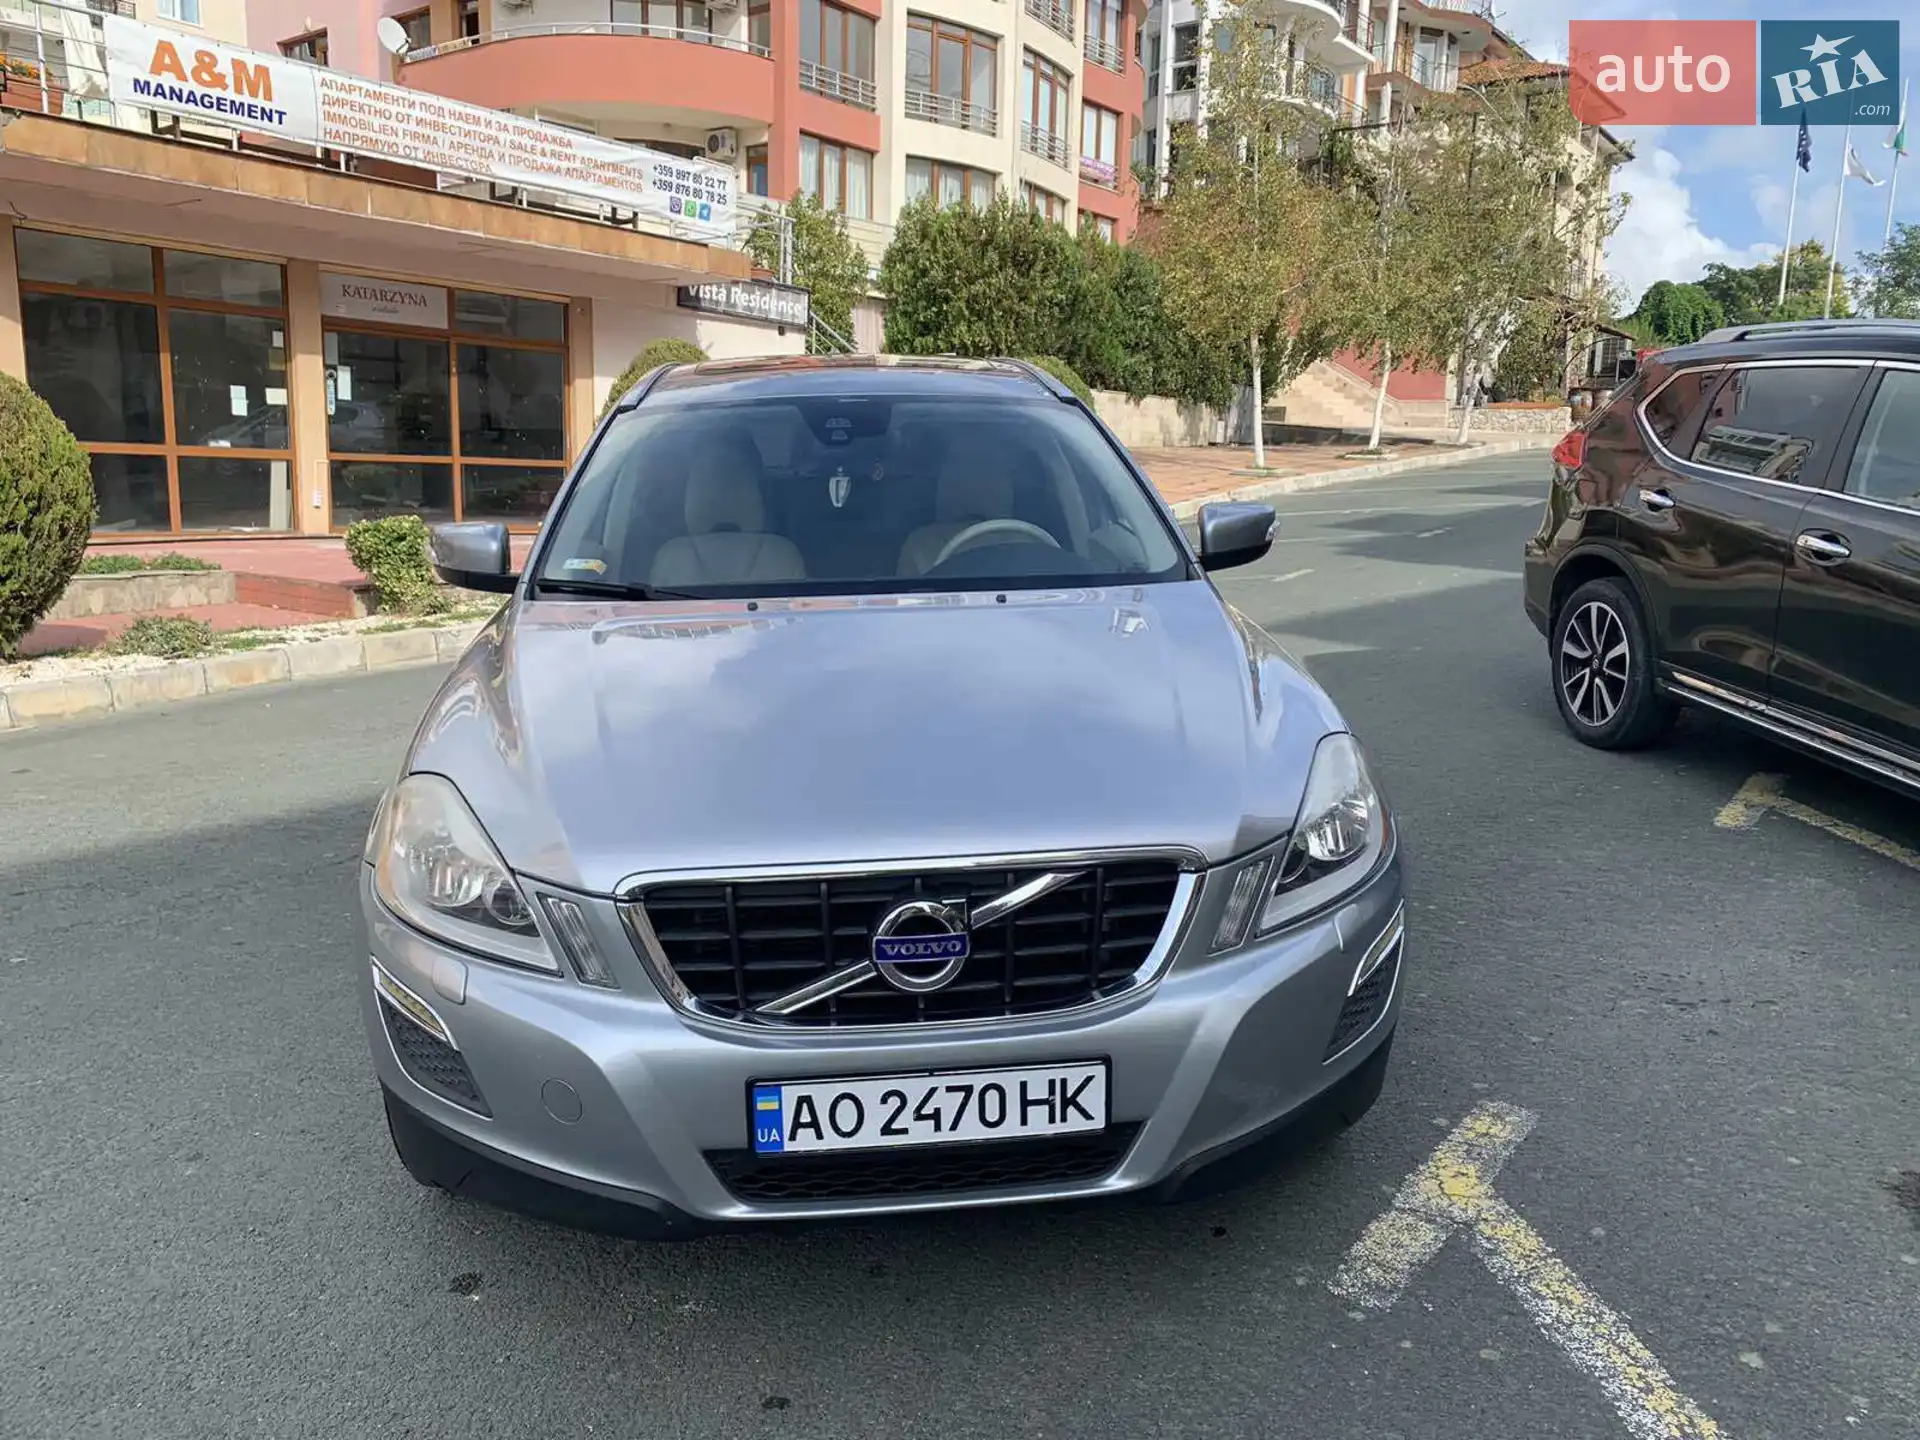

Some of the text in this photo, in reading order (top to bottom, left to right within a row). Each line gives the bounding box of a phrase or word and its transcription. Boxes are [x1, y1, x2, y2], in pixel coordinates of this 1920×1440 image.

[150, 39, 273, 102] A&M
[133, 77, 287, 126] MANAGEMENT
[320, 77, 573, 149] АПАРТАМЕНТИ ПОД НАЕМ И ЗА ПРОДАЖБА
[321, 93, 392, 120] ДИРЕКТНО
[395, 111, 413, 125] ОТ
[415, 115, 501, 146] ИНВЕСТИТОРА
[509, 138, 539, 157] SALE
[550, 148, 578, 165] RENT
[580, 155, 644, 180] APARTMENTS
[323, 127, 493, 173] НАПРЯМУЮ ОТ ИНВЕСТОРА
[323, 110, 399, 139] IMMOBILIEN
[402, 129, 441, 147] FIRMA
[449, 140, 496, 161] АРЕНДА
[498, 151, 506, 163] И
[508, 152, 563, 177] ПРОДАЖА
[564, 167, 643, 193] АПАРТАМЕНТОВ
[652, 178, 674, 192] +359
[716, 193, 727, 206] 25
[653, 164, 674, 178] +359
[675, 169, 691, 182] 897
[704, 176, 715, 188] 22
[717, 178, 727, 191] 77
[341, 283, 428, 308] KATARZYNA
[687, 283, 802, 316] Vista Residence
[881, 940, 962, 956] VOLVO
[788, 1074, 1096, 1142] AO 2470 HK
[757, 1128, 780, 1144] UA
